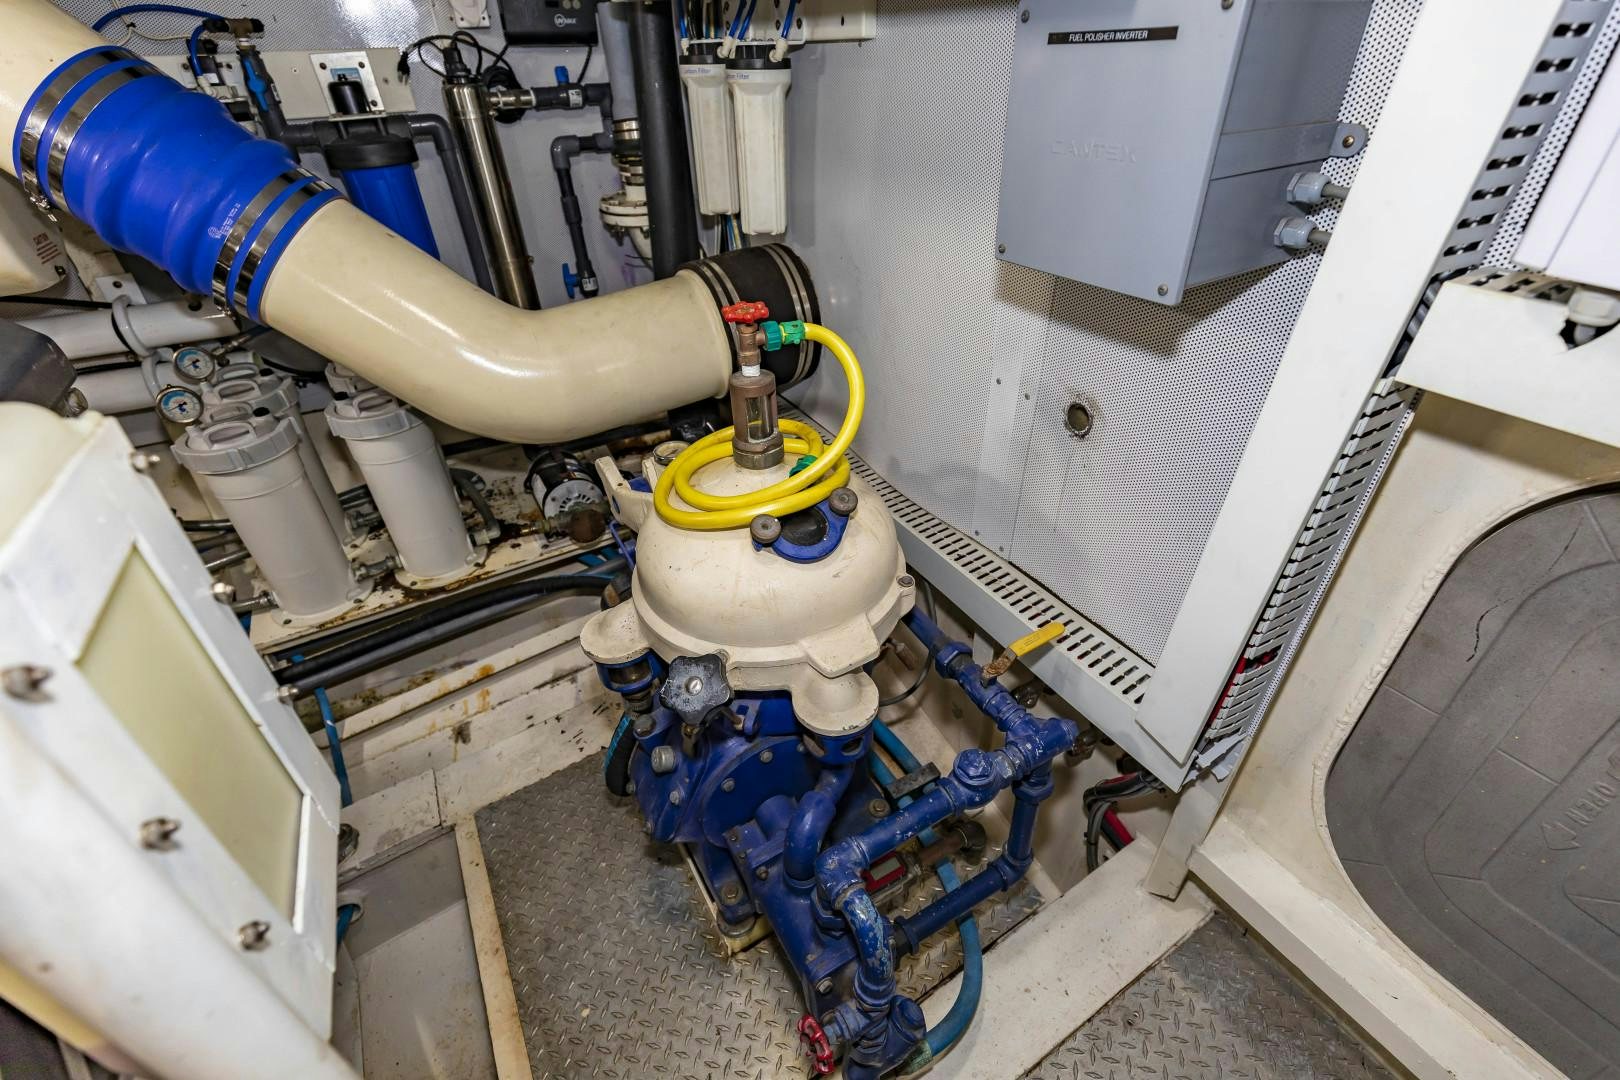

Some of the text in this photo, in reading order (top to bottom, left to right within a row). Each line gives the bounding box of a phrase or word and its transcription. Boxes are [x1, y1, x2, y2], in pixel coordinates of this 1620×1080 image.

[1068, 29, 1149, 42] FUEL POLISHER INVERTER
[1565, 781, 1617, 827] OPEN
